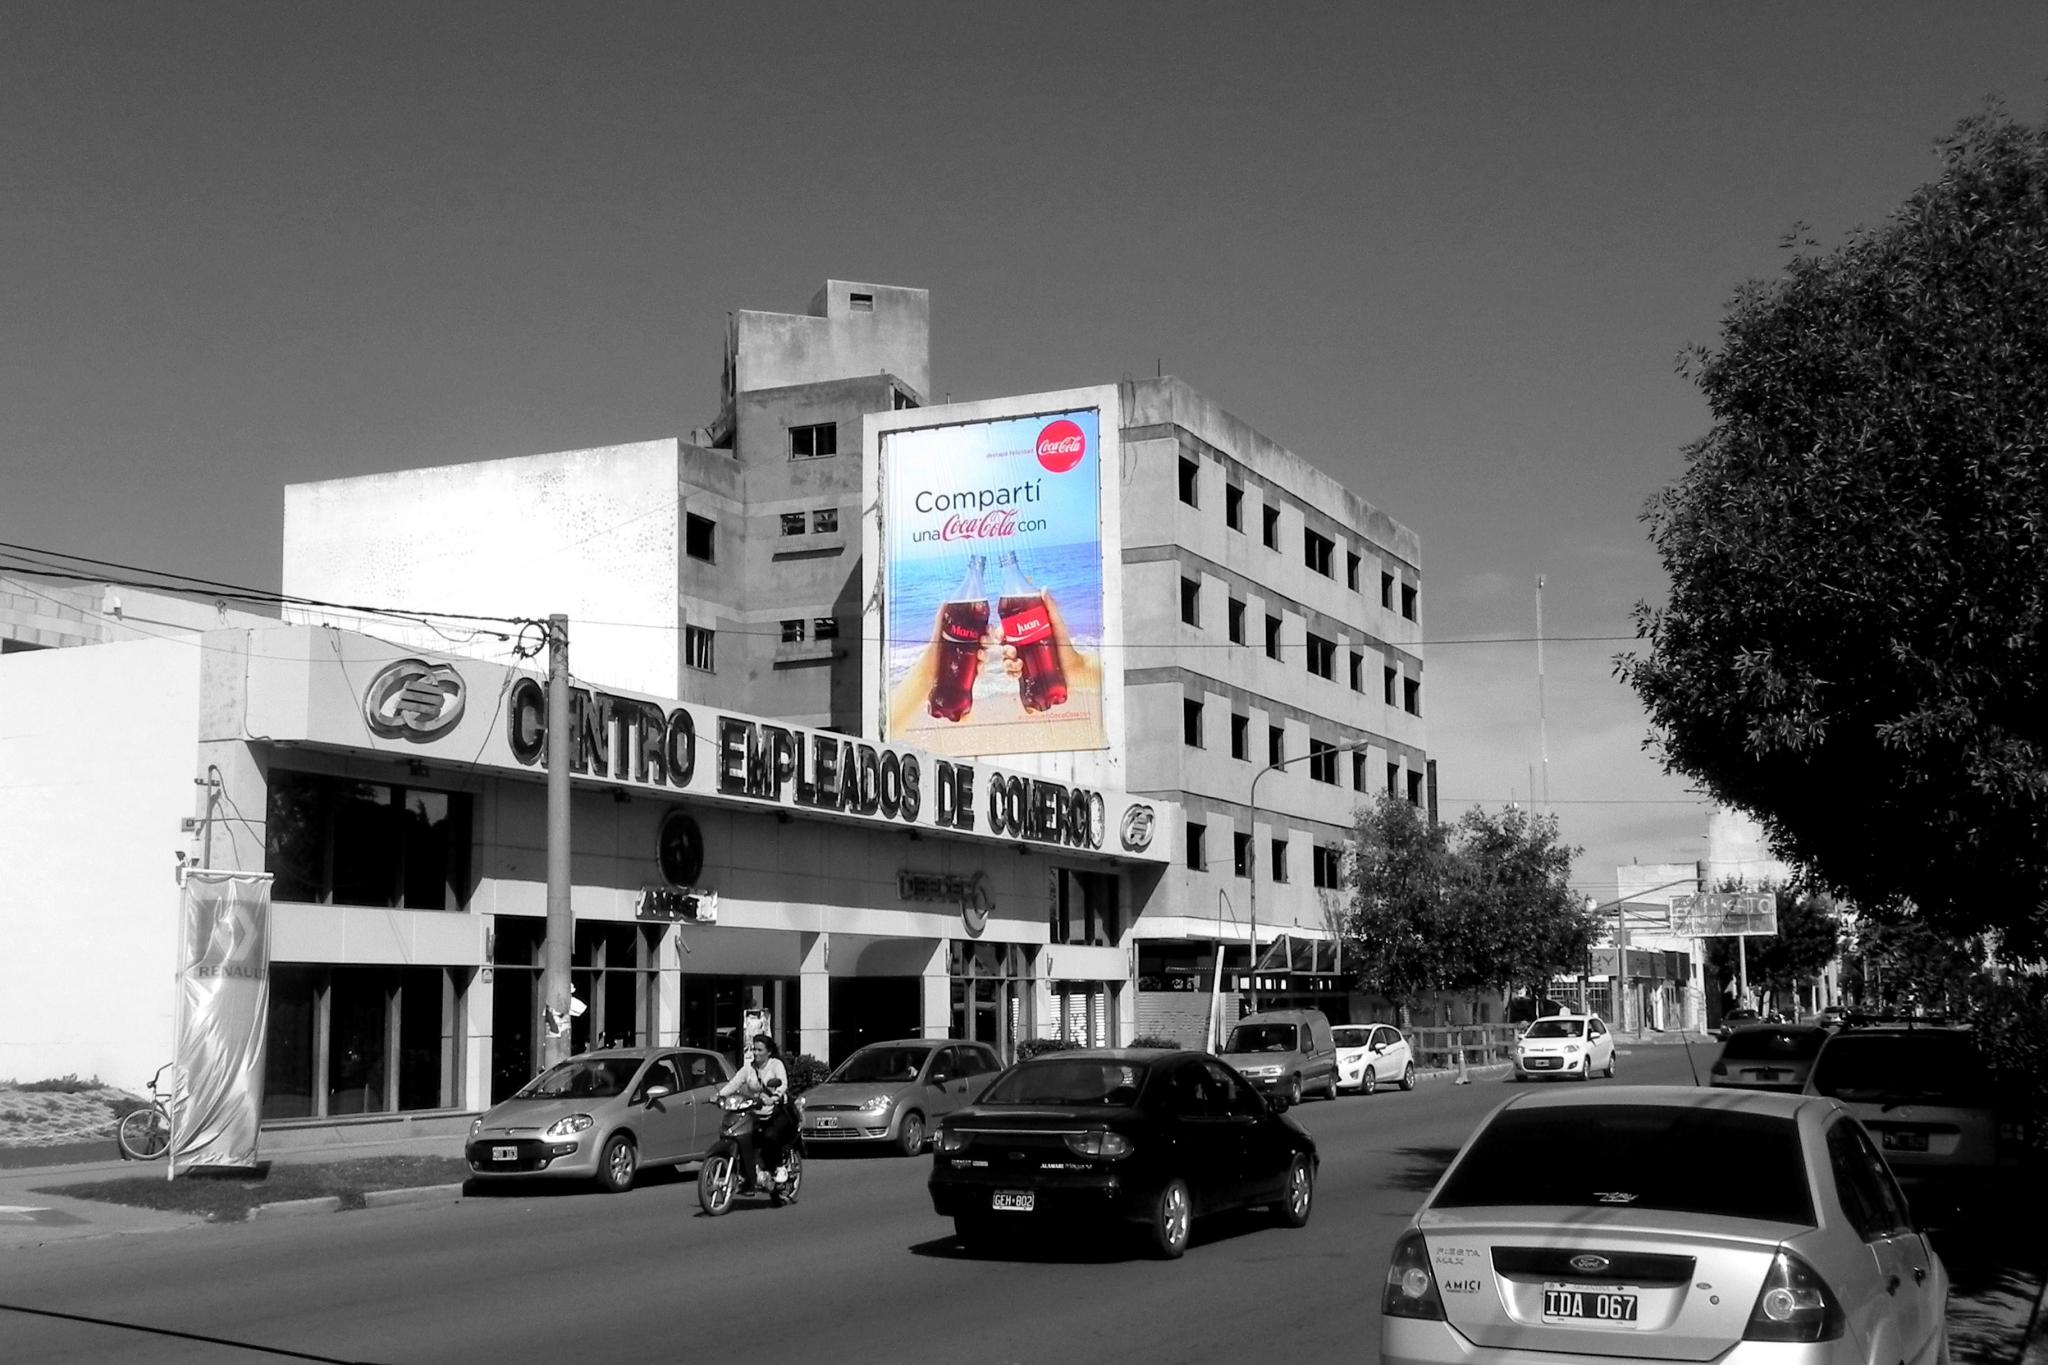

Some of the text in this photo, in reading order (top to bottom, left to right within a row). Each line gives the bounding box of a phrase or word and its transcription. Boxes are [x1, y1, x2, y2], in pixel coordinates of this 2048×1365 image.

[915, 478, 1042, 513] Compartí
[912, 529, 941, 543] una
[1017, 518, 1047, 533] con
[1016, 619, 1040, 635] Juan
[716, 714, 921, 823] EMPLEADOS
[934, 759, 975, 831] DE
[986, 771, 1106, 850] COMERCIO
[1578, 1258, 1600, 1269] Ford
[1444, 1280, 1481, 1290] AMICI
[1546, 1291, 1636, 1319] IDA 067
